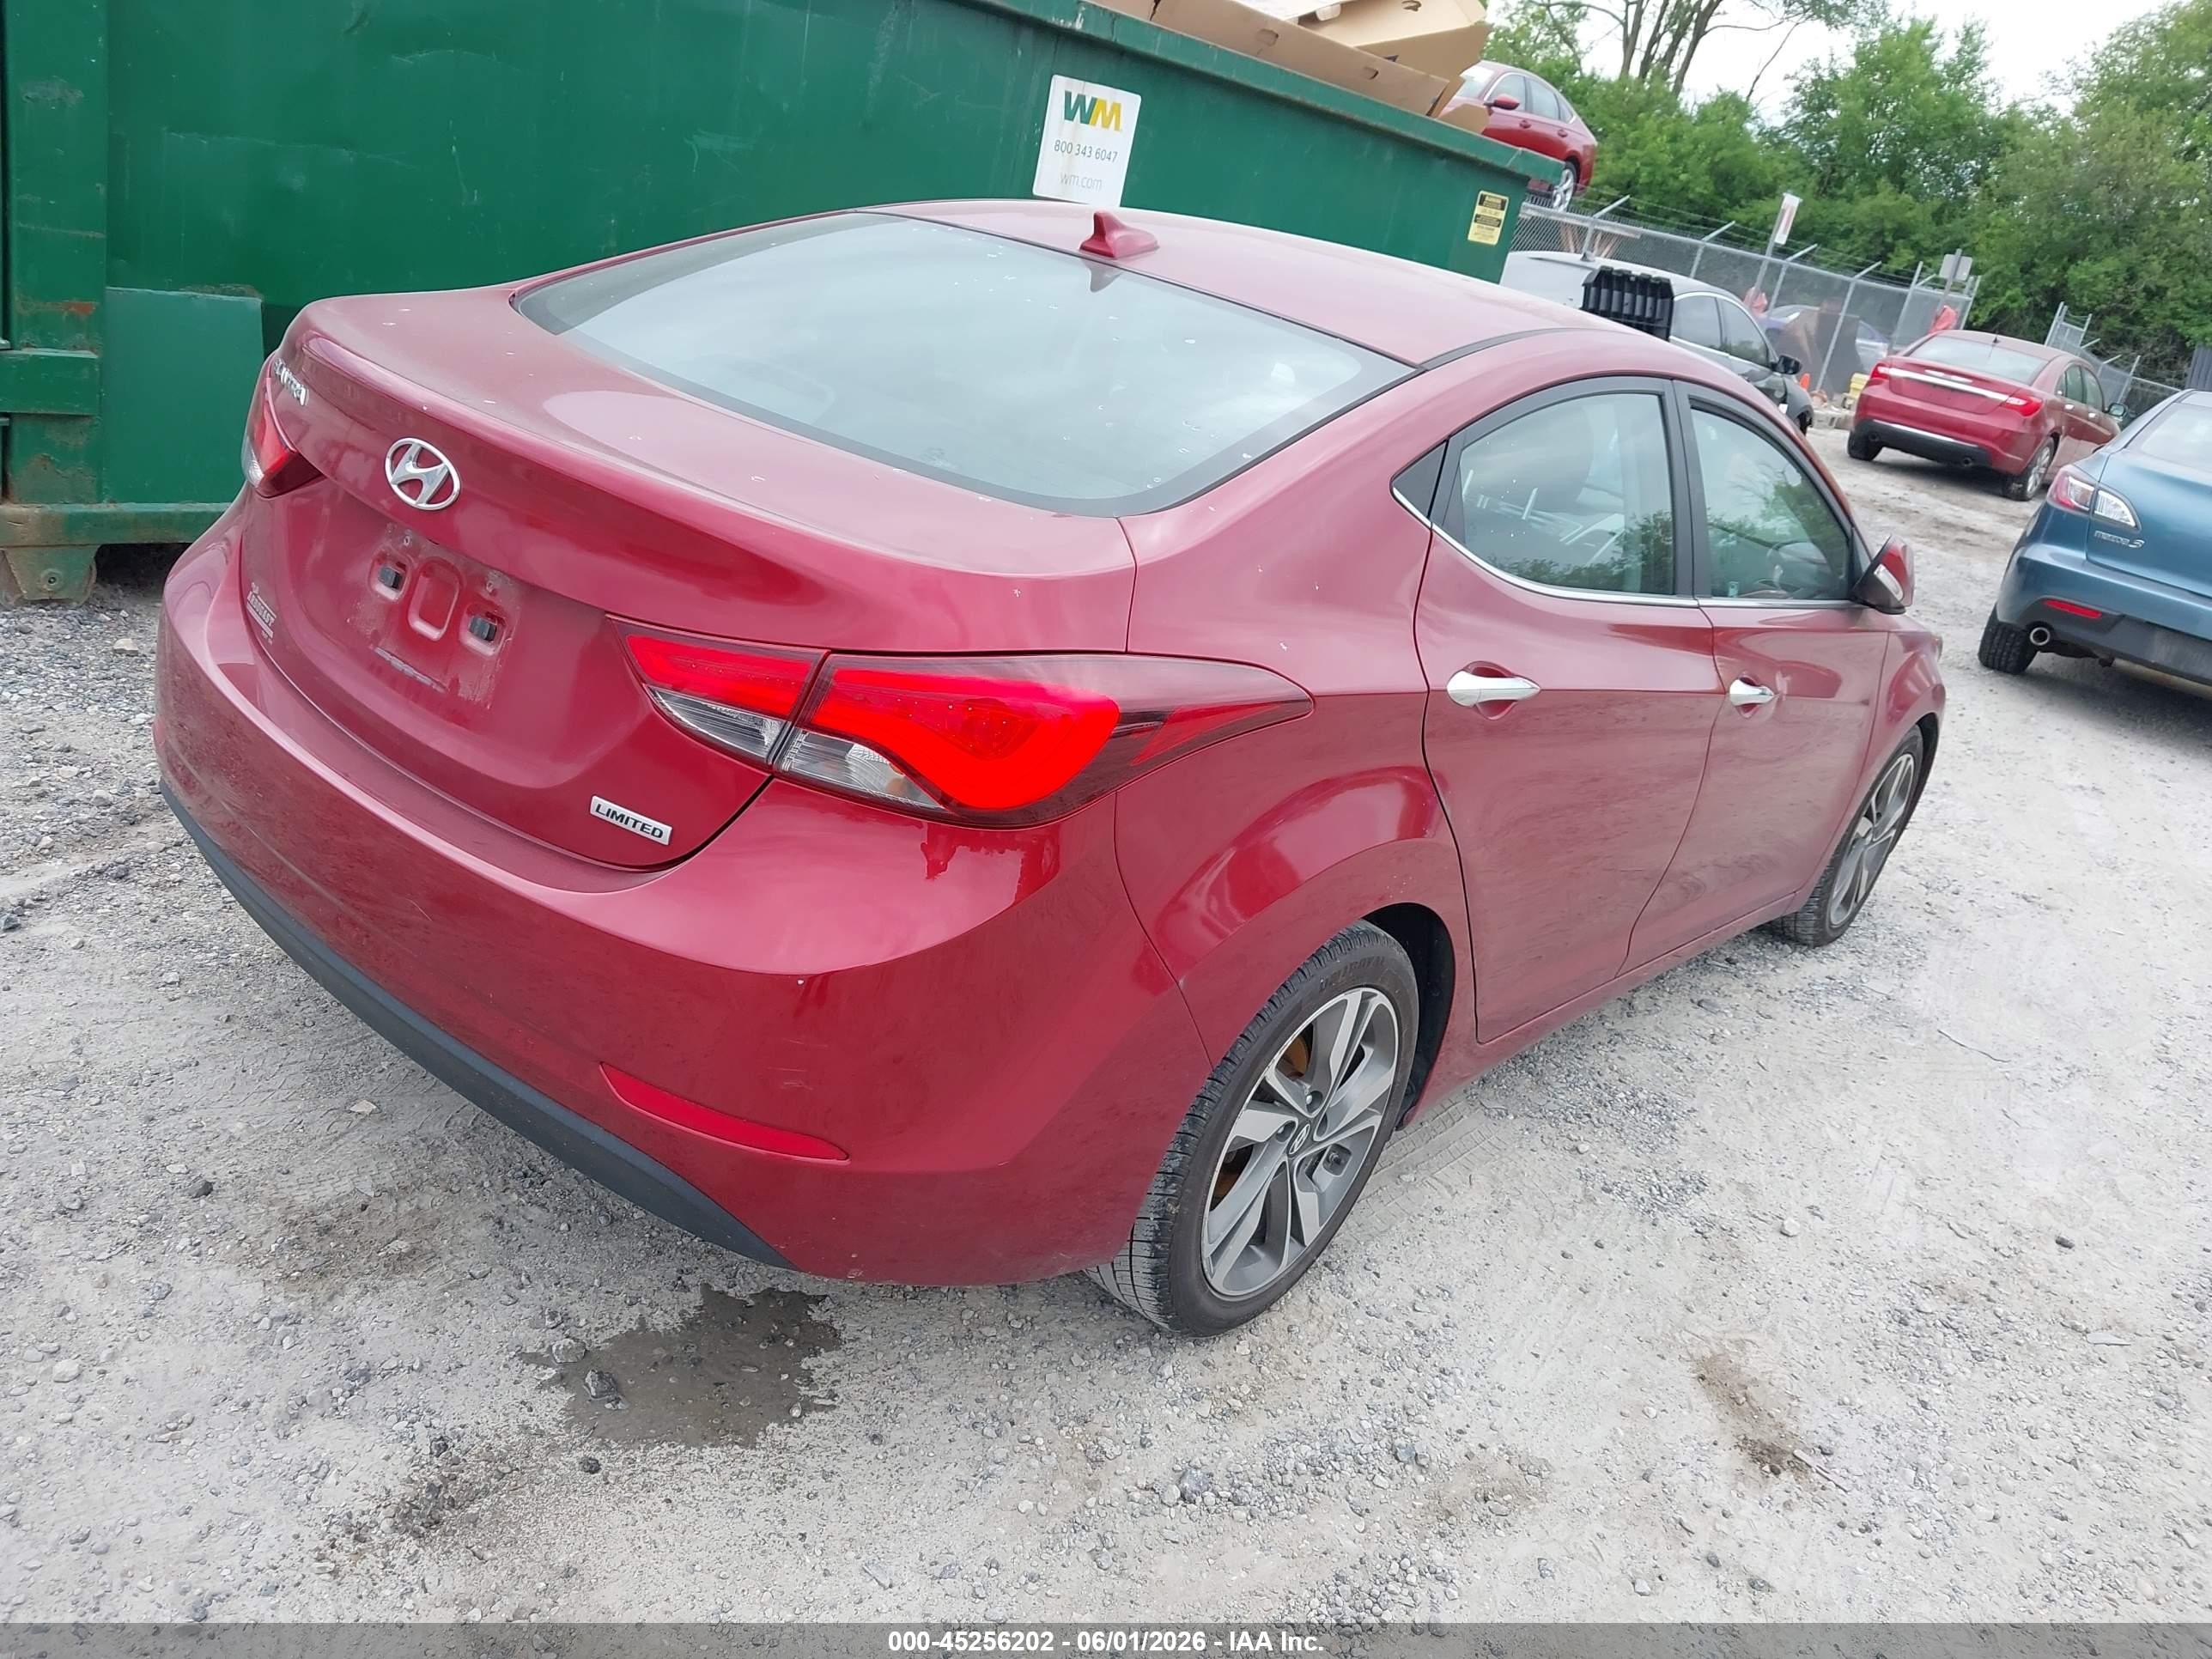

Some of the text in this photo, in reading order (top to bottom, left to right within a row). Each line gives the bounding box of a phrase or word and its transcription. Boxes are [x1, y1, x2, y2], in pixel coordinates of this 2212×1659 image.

[1064, 90, 1121, 131] WM
[1054, 139, 1118, 163] 800 343 6047
[1060, 173, 1103, 191] wm.com
[594, 803, 664, 839] LIMITED
